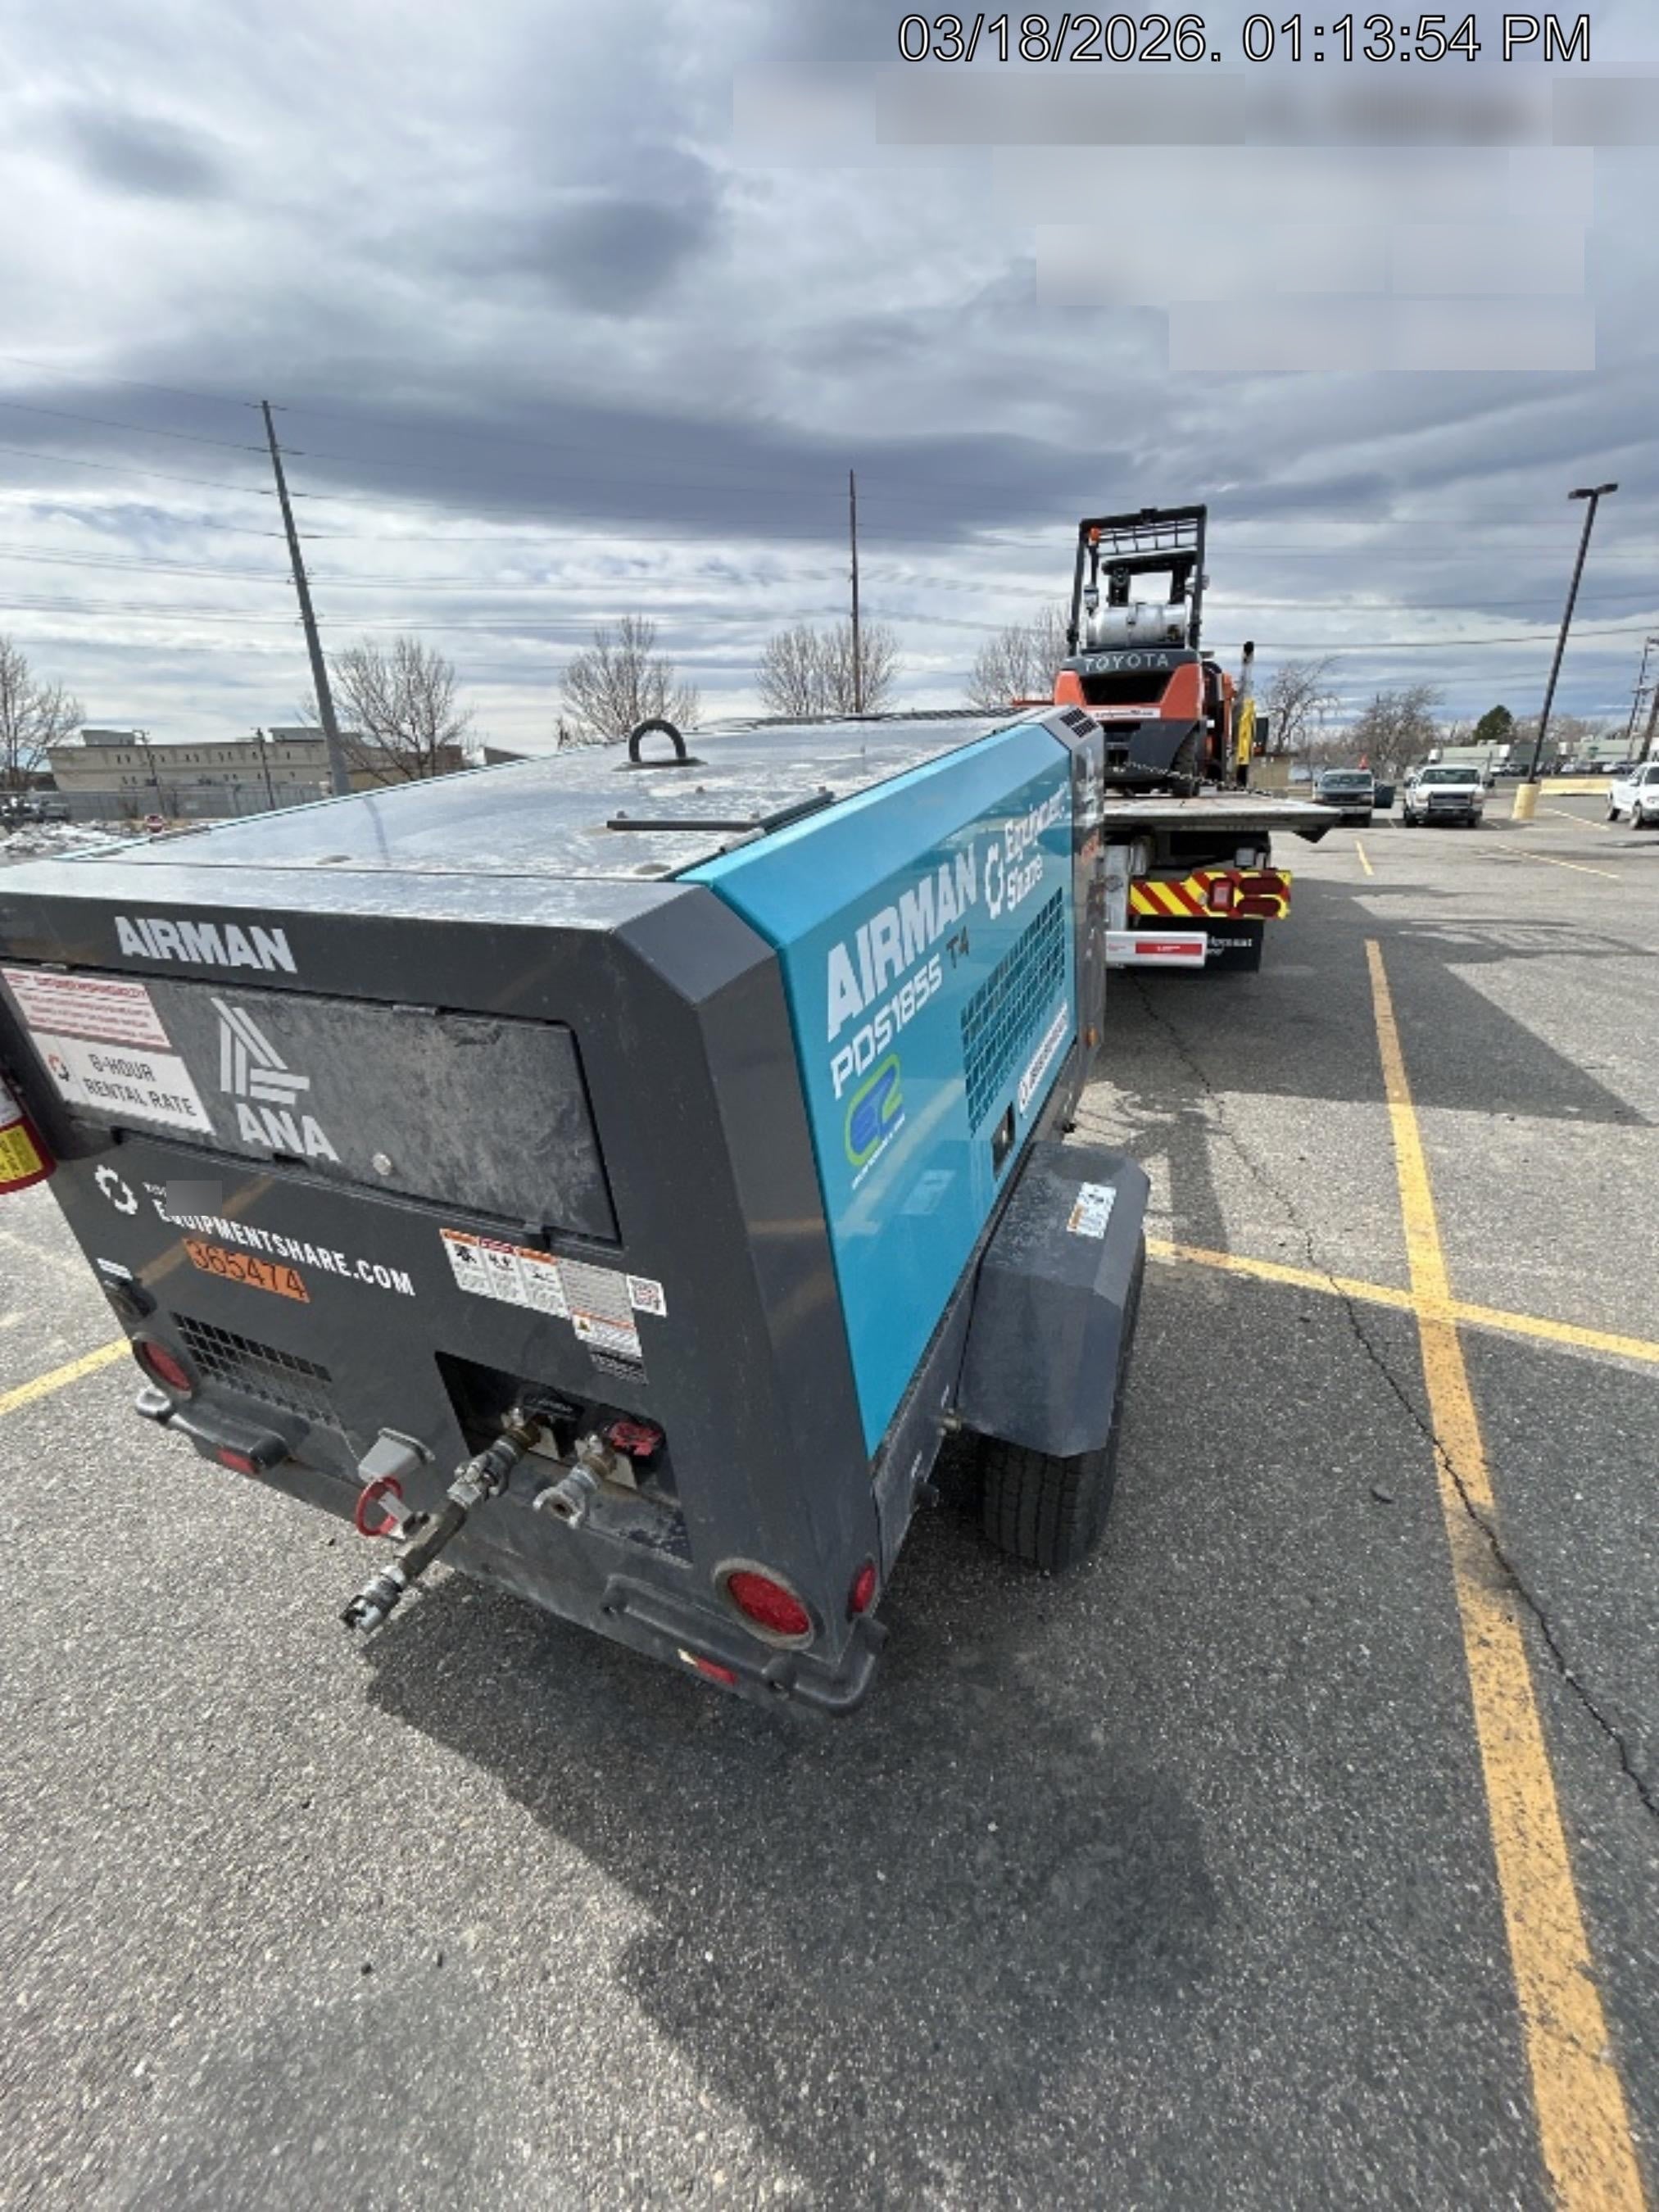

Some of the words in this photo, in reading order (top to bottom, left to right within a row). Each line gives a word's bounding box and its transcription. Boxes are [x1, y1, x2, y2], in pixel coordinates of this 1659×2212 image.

[1084, 653, 1169, 673] TOYOTA
[114, 916, 298, 973] AIRMAN
[827, 842, 977, 1043] AIRMAN
[83, 1077, 147, 1106] RENTAL
[147, 1090, 197, 1117] RATE
[235, 1103, 341, 1163] ANA
[184, 1239, 307, 1298] 365474
